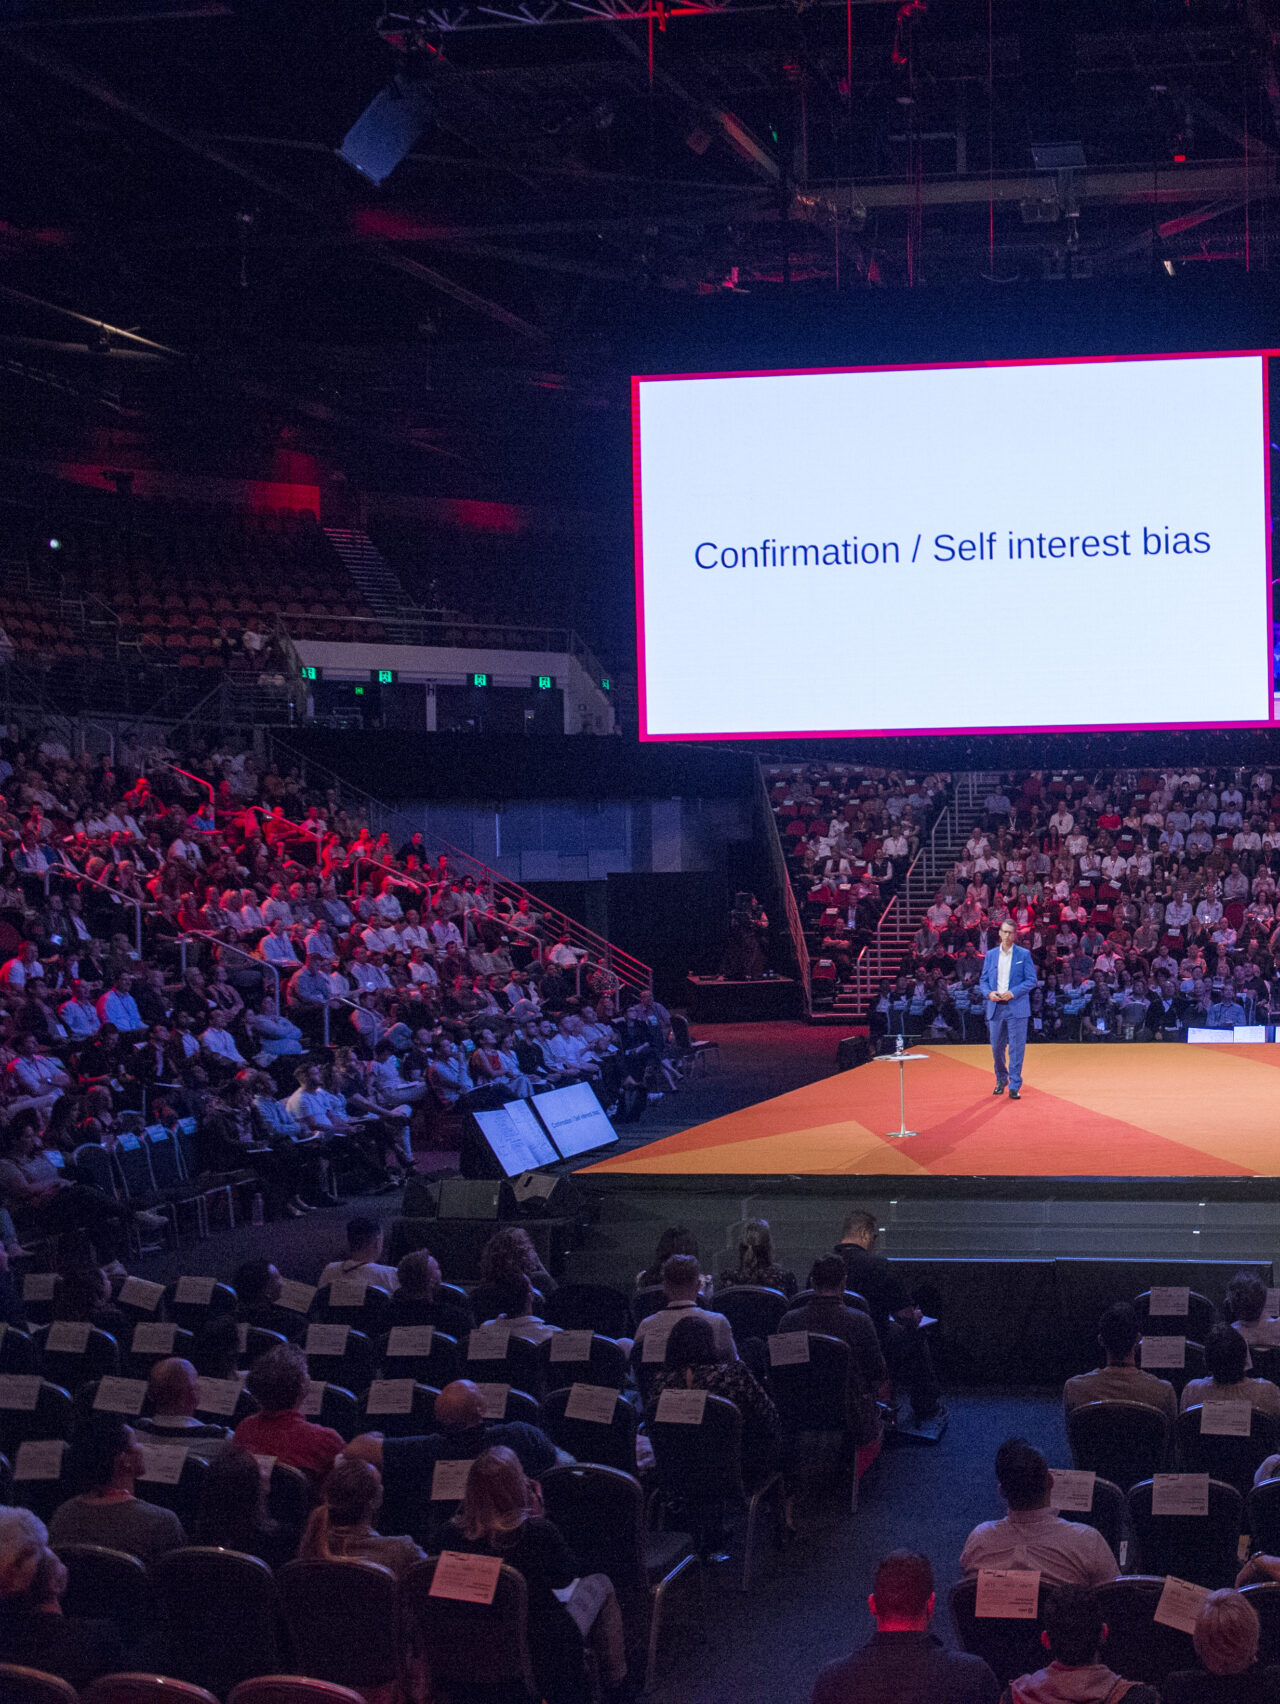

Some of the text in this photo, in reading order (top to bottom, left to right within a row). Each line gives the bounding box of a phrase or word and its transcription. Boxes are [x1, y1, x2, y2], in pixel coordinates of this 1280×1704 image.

[694, 526, 1211, 569] Confirmation / Self interest bias
